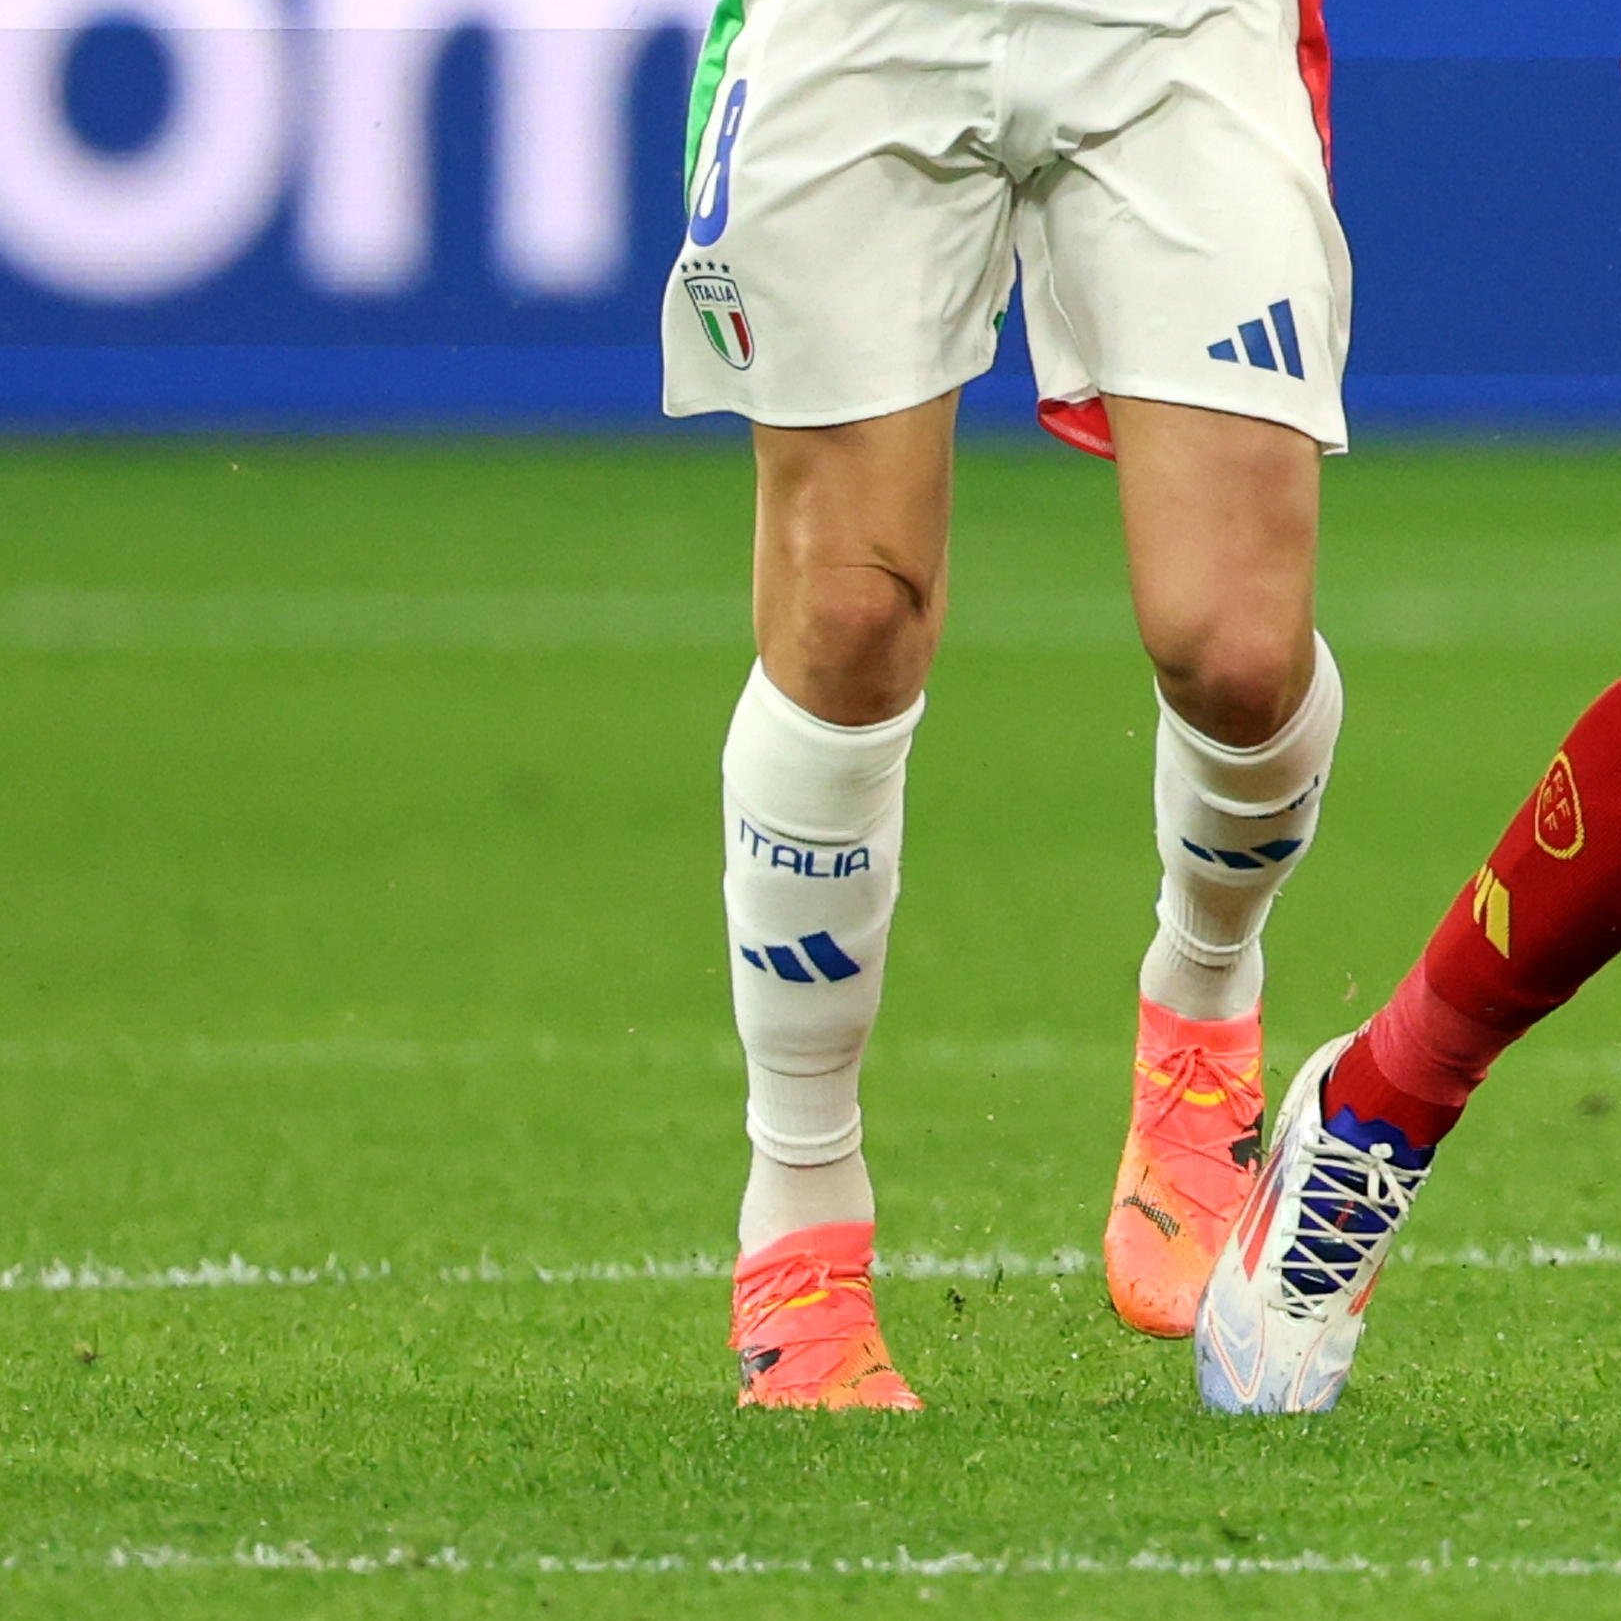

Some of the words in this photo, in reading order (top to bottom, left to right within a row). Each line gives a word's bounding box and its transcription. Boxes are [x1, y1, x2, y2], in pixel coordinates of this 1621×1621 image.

[690, 78, 748, 247] 8
[689, 284, 737, 303] ITALIA
[740, 818, 870, 878] ITALIA
